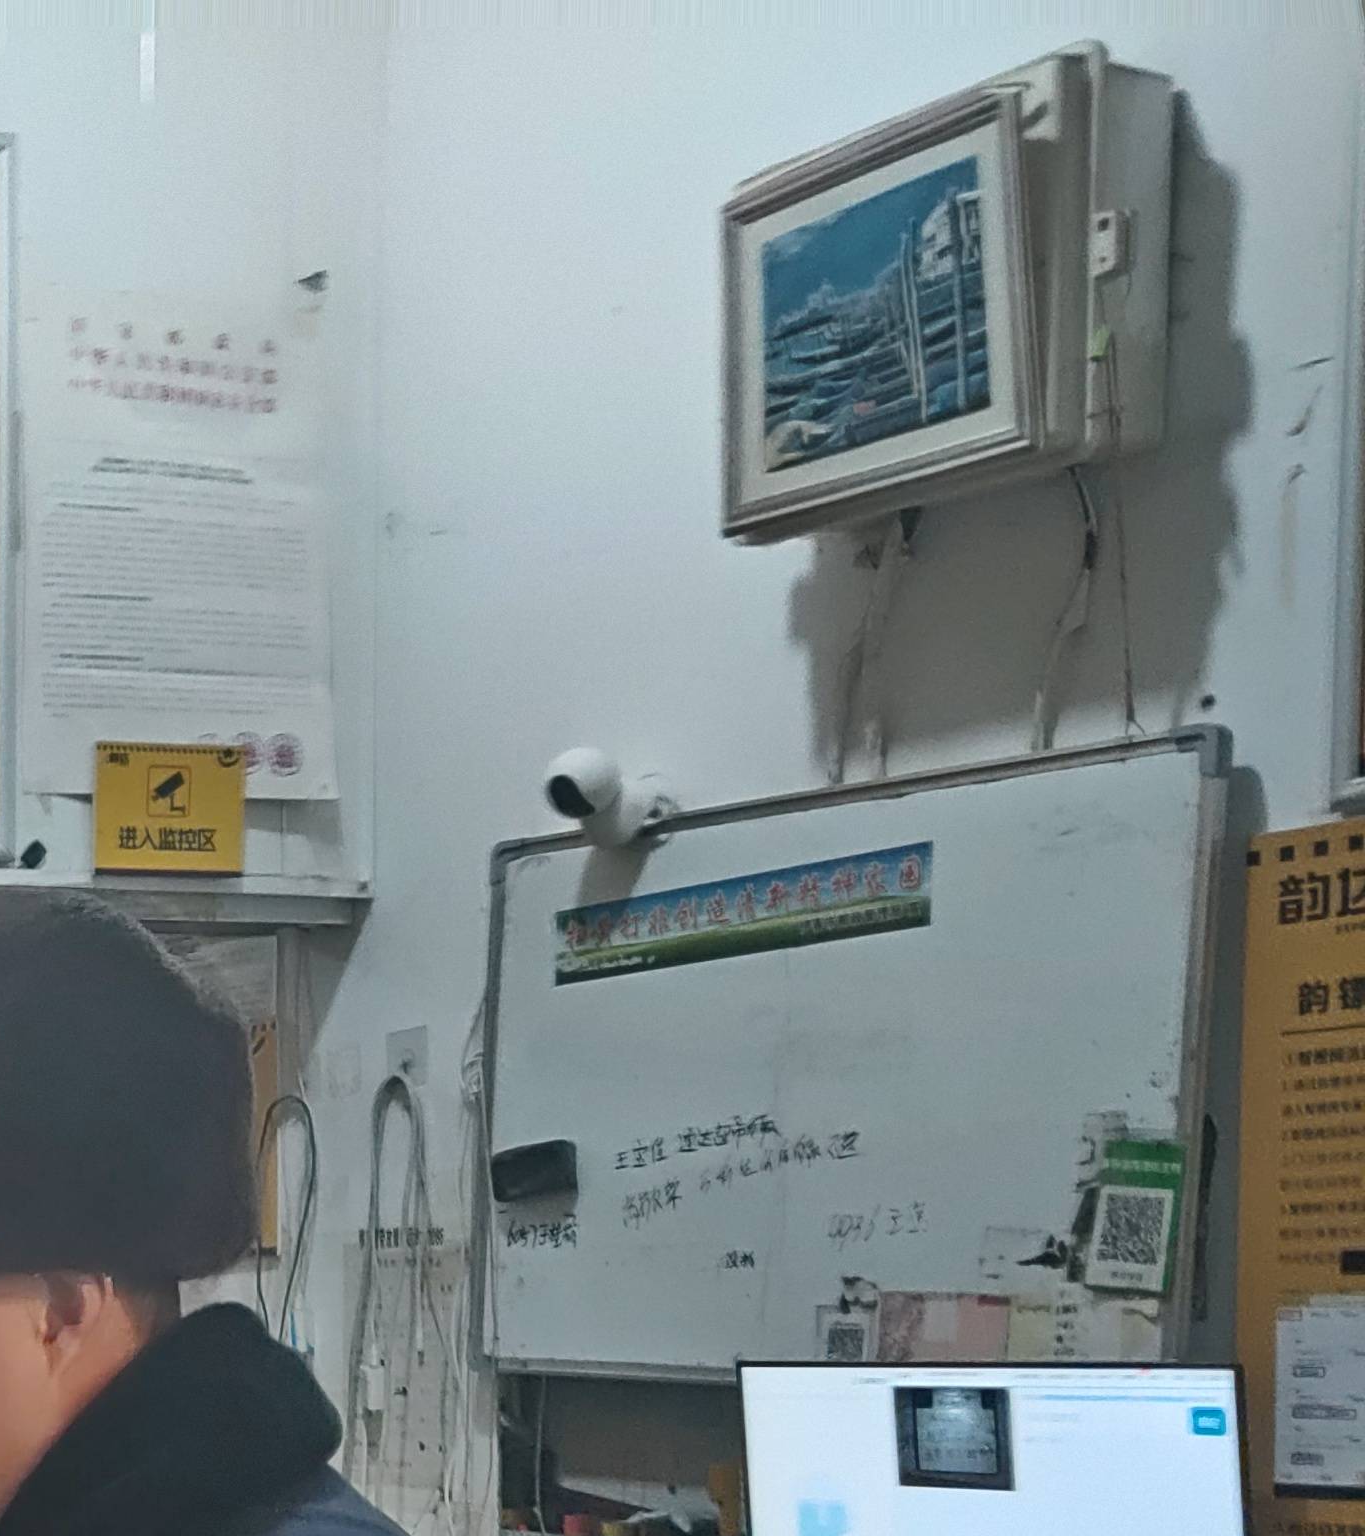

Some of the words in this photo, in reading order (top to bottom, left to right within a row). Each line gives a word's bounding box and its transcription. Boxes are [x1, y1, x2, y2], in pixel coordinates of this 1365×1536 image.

[118, 825, 217, 852] 进入监控区
